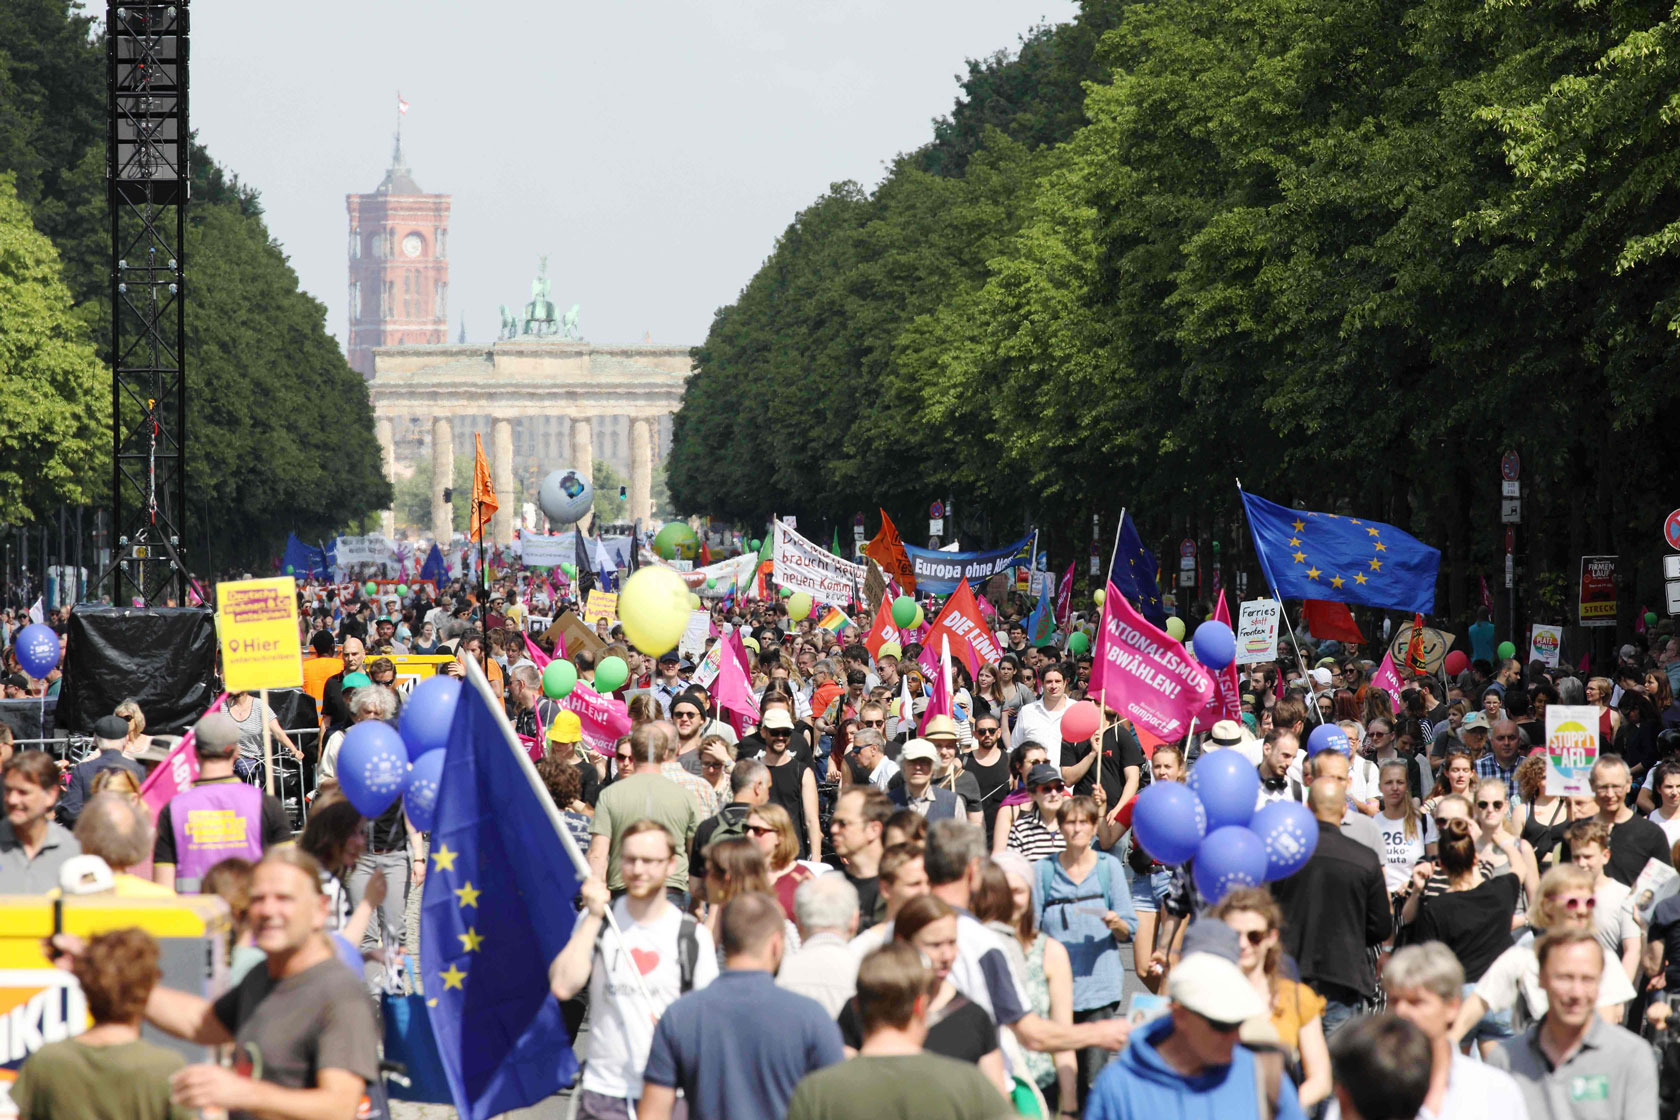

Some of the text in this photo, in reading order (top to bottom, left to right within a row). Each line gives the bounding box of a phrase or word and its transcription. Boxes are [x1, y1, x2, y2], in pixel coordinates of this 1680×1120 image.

[914, 557, 961, 579] Europa
[965, 561, 993, 578] ohne
[1588, 563, 1615, 571] FIRMEN
[782, 572, 815, 589] neuen
[1242, 606, 1276, 618] Ferries
[1583, 604, 1615, 614] STRECK
[942, 610, 975, 637] DIE
[965, 627, 1002, 668] LINK
[1240, 627, 1266, 637] Frontex
[243, 638, 281, 653] Hier
[1106, 641, 1182, 700] BWÄHLEN!
[1551, 731, 1592, 748] STOPPT
[1561, 747, 1586, 768] AFD
